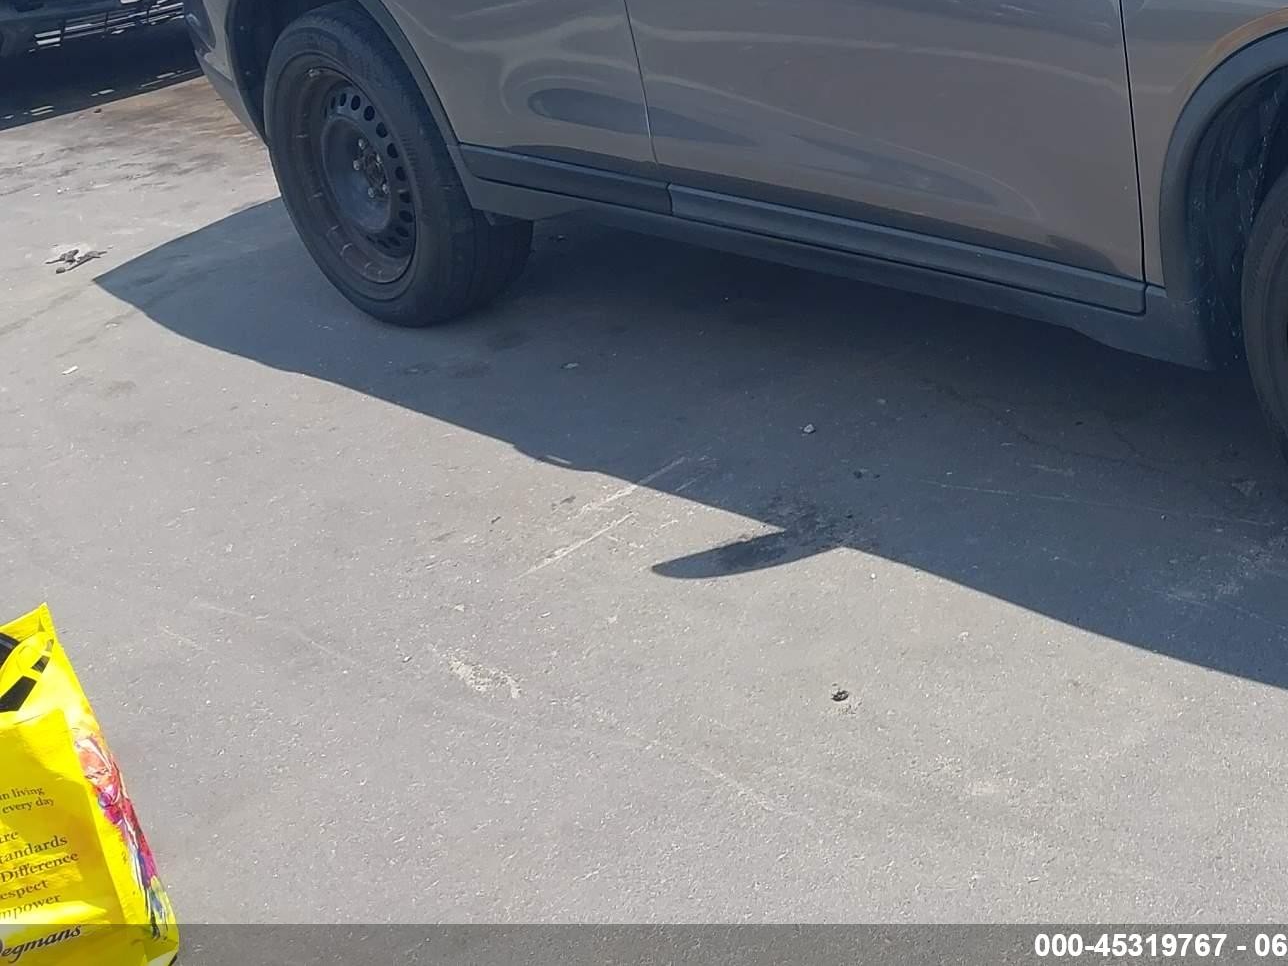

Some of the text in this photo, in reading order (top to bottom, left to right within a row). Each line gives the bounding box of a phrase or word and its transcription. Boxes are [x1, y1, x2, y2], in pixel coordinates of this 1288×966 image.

[11, 787, 45, 798] living
[2, 797, 54, 814] every day
[0, 853, 79, 882] Difference
[0, 880, 48, 899] espect
[0, 895, 61, 920] mpower
